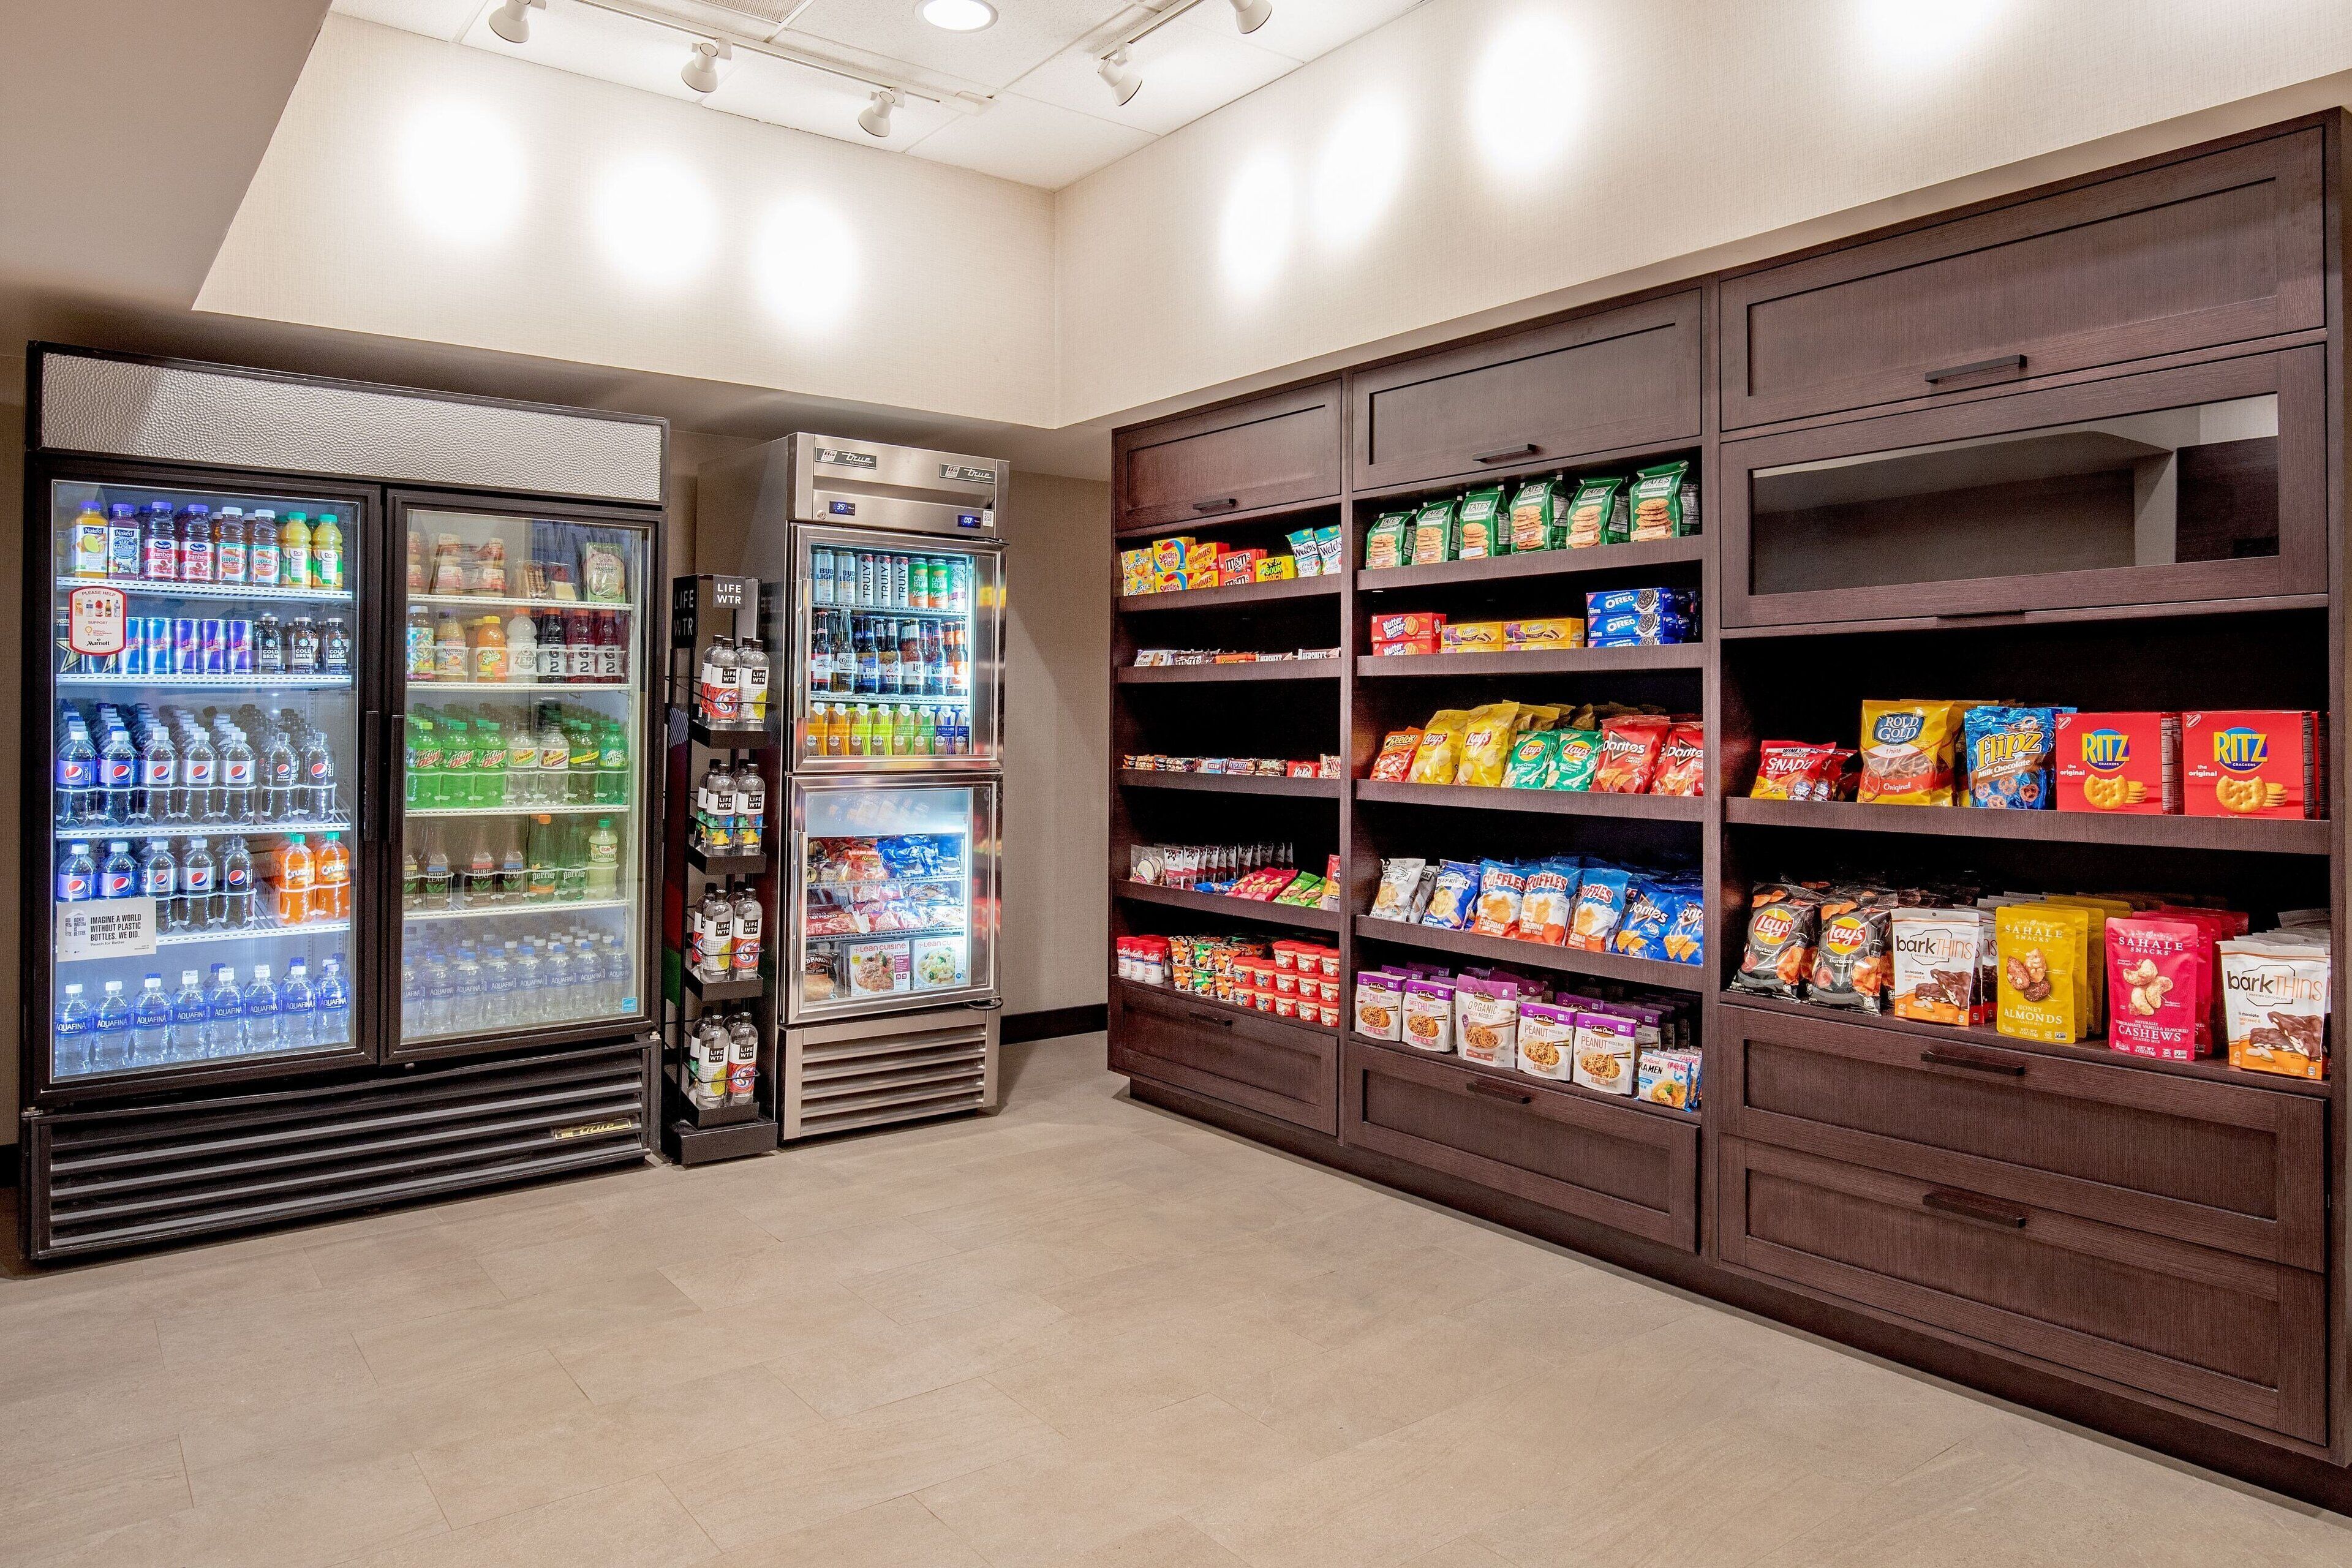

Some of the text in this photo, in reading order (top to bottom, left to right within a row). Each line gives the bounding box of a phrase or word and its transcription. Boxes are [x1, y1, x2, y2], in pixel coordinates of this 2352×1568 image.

[842, 453, 874, 463] true
[964, 469, 993, 479] true
[1644, 477, 1671, 485] TATE'S
[1523, 484, 1544, 494] TATE'S
[1294, 541, 1317, 557] Welch's
[1321, 538, 1342, 555] Welch's
[1159, 552, 1177, 564] Swedish
[1188, 545, 1213, 565] Starburst
[1164, 559, 1175, 567] Fish
[1265, 565, 1282, 575] SOUR
[862, 565, 871, 598] TRULY
[898, 567, 907, 600] TRULY
[1160, 582, 1180, 592] Swedish
[717, 583, 741, 593] LIFE
[675, 589, 693, 609] LIFE
[717, 595, 741, 604] WTR
[1605, 595, 1634, 609] OREO
[674, 617, 693, 636] WTR
[1383, 616, 1403, 628] Nutter
[1606, 619, 1635, 633] OREO
[1383, 624, 1405, 636] Butter
[1384, 643, 1404, 655] Nutter
[482, 654, 501, 665] Splash
[550, 662, 559, 673] 2
[581, 662, 589, 673] 2
[606, 662, 615, 673] 2
[1885, 715, 1919, 727] ROLD
[1423, 733, 1446, 745] Lay's
[1466, 731, 1491, 747] Lay's
[1878, 726, 1918, 740] GOLD
[1385, 735, 1417, 747] Cheetos
[1604, 739, 1645, 753] Doritos
[2214, 731, 2268, 763] RITZ
[1520, 742, 1543, 758] Lay's
[1563, 744, 1591, 756] Lay's
[1977, 731, 2042, 771] Flipz
[2081, 733, 2130, 763] RITZ
[514, 751, 534, 763] Schweppes
[545, 752, 564, 763] Schweppes
[606, 753, 625, 766] MIST
[1978, 759, 2030, 778] Milk Chocolate
[1883, 782, 1911, 793] Original
[287, 870, 310, 879] Crush
[321, 864, 345, 875] Crush
[563, 870, 586, 880] perrier
[532, 871, 555, 881] perrier
[1526, 873, 1567, 891] RUFFLES
[1483, 873, 1526, 892] RUFFLES
[1580, 885, 1613, 903] RUFFLES
[1630, 902, 1668, 924] Doritos
[91, 924, 116, 932] WITHOUT
[1479, 918, 1505, 929] CHEDDAR
[1521, 920, 1544, 931] CHEDDAR
[1755, 915, 1792, 933] Lay's
[91, 932, 116, 941] BOTTLES.
[1829, 925, 1864, 943] Lay's
[2005, 925, 2063, 938] SAHALE
[1754, 944, 1780, 954] Barbecue
[2119, 937, 2183, 951] SAHALE
[2130, 947, 2169, 956] SNACKS
[320, 997, 347, 1008] AQUAFINA
[1370, 993, 1381, 1003] CHILI
[250, 1003, 278, 1013] AQUAFINA
[286, 1000, 314, 1009] AQUAFINA
[1417, 1002, 1430, 1012] CHILI
[1468, 1000, 1498, 1014] ORGANIC
[178, 1010, 205, 1019] AQUAFINA
[214, 1006, 243, 1016] AQUAFINA
[2004, 1008, 2062, 1024] ALMONDS
[97, 1018, 127, 1028] AQUAFINA
[137, 1014, 167, 1024] AQUAFINA
[56, 1022, 86, 1031] AQUAFINA
[1525, 1025, 1548, 1037] PEANUT
[2119, 1025, 2181, 1041] CASHEWS
[1581, 1036, 1607, 1050] PEANUT
[1639, 1063, 1662, 1074] RAMEN
